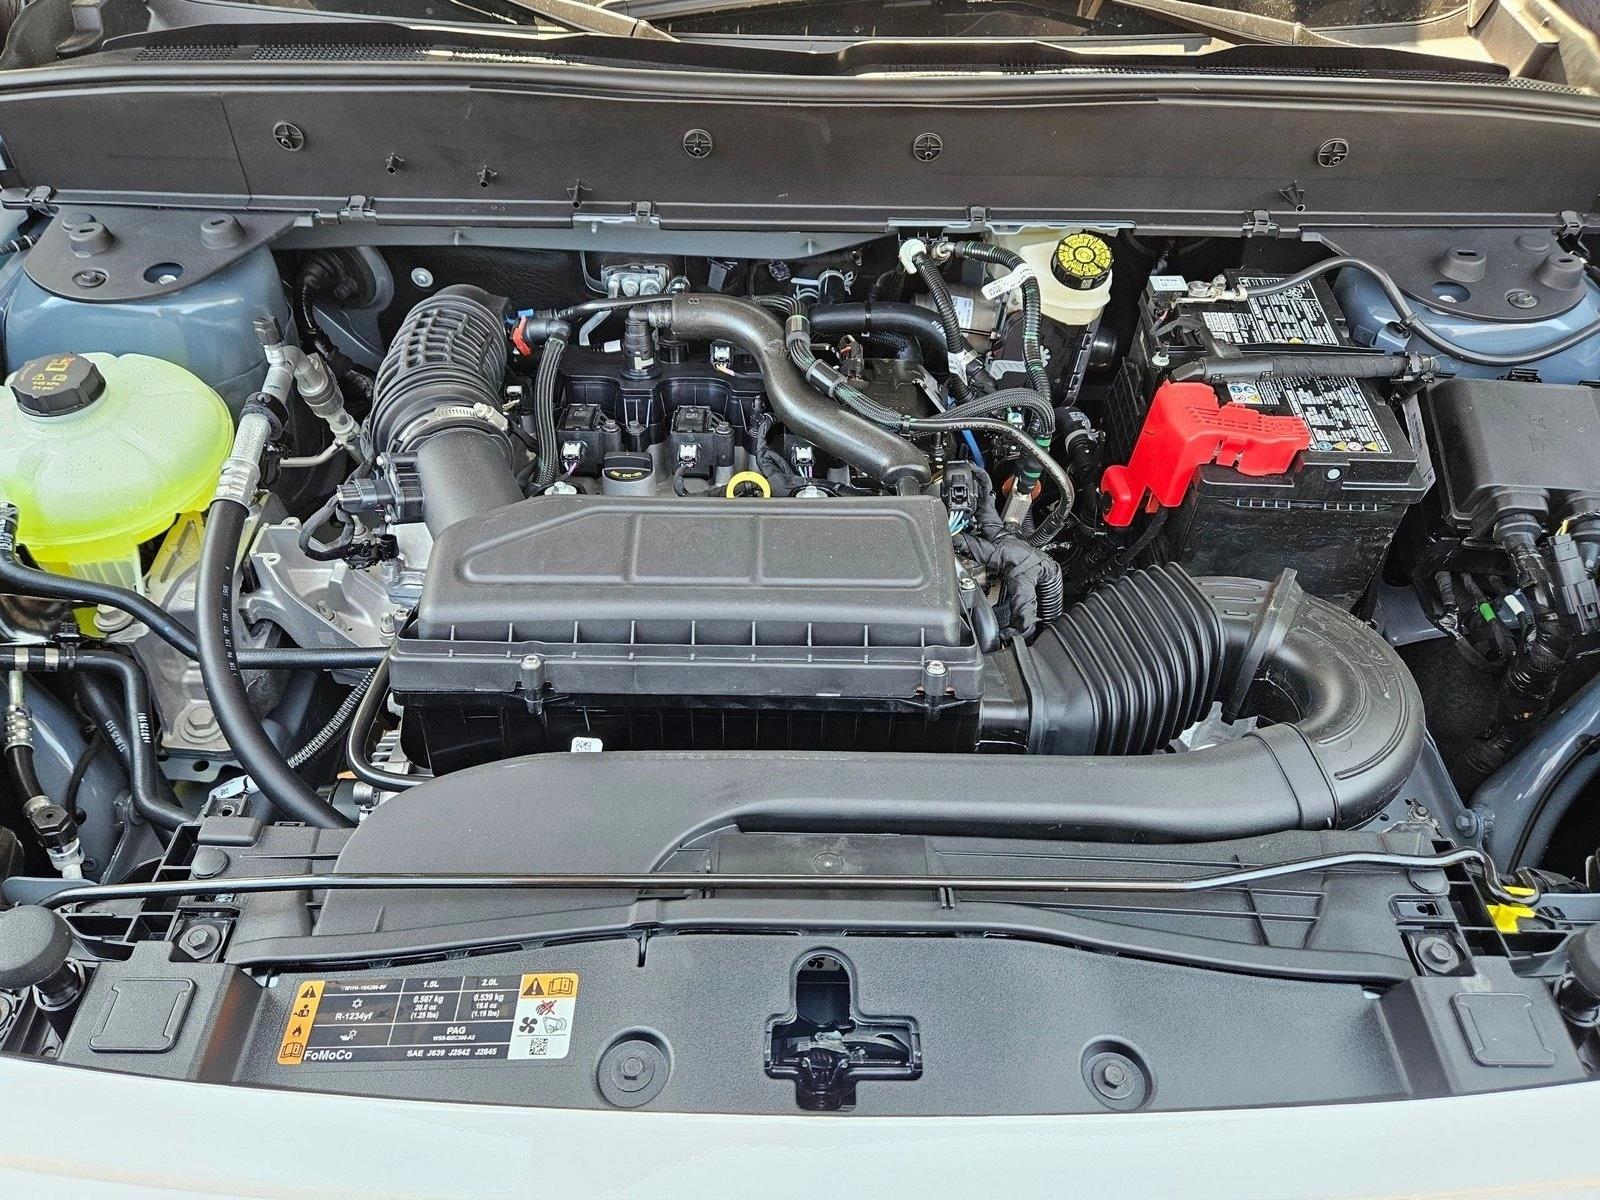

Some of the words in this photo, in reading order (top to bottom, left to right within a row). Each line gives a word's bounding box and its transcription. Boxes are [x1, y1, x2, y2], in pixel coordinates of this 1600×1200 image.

[423, 980, 440, 988] 1.5L
[481, 978, 499, 986] 2.0L
[433, 994, 445, 1005] kg
[494, 992, 505, 1003] kg
[334, 1011, 374, 1022] R-1234yf
[446, 1026, 466, 1035] PAG
[303, 1049, 353, 1061] FoMoCo
[406, 1049, 424, 1058] SAE
[426, 1048, 446, 1057] J639
[447, 1047, 471, 1057] J2842
[474, 1047, 498, 1056] J2845
